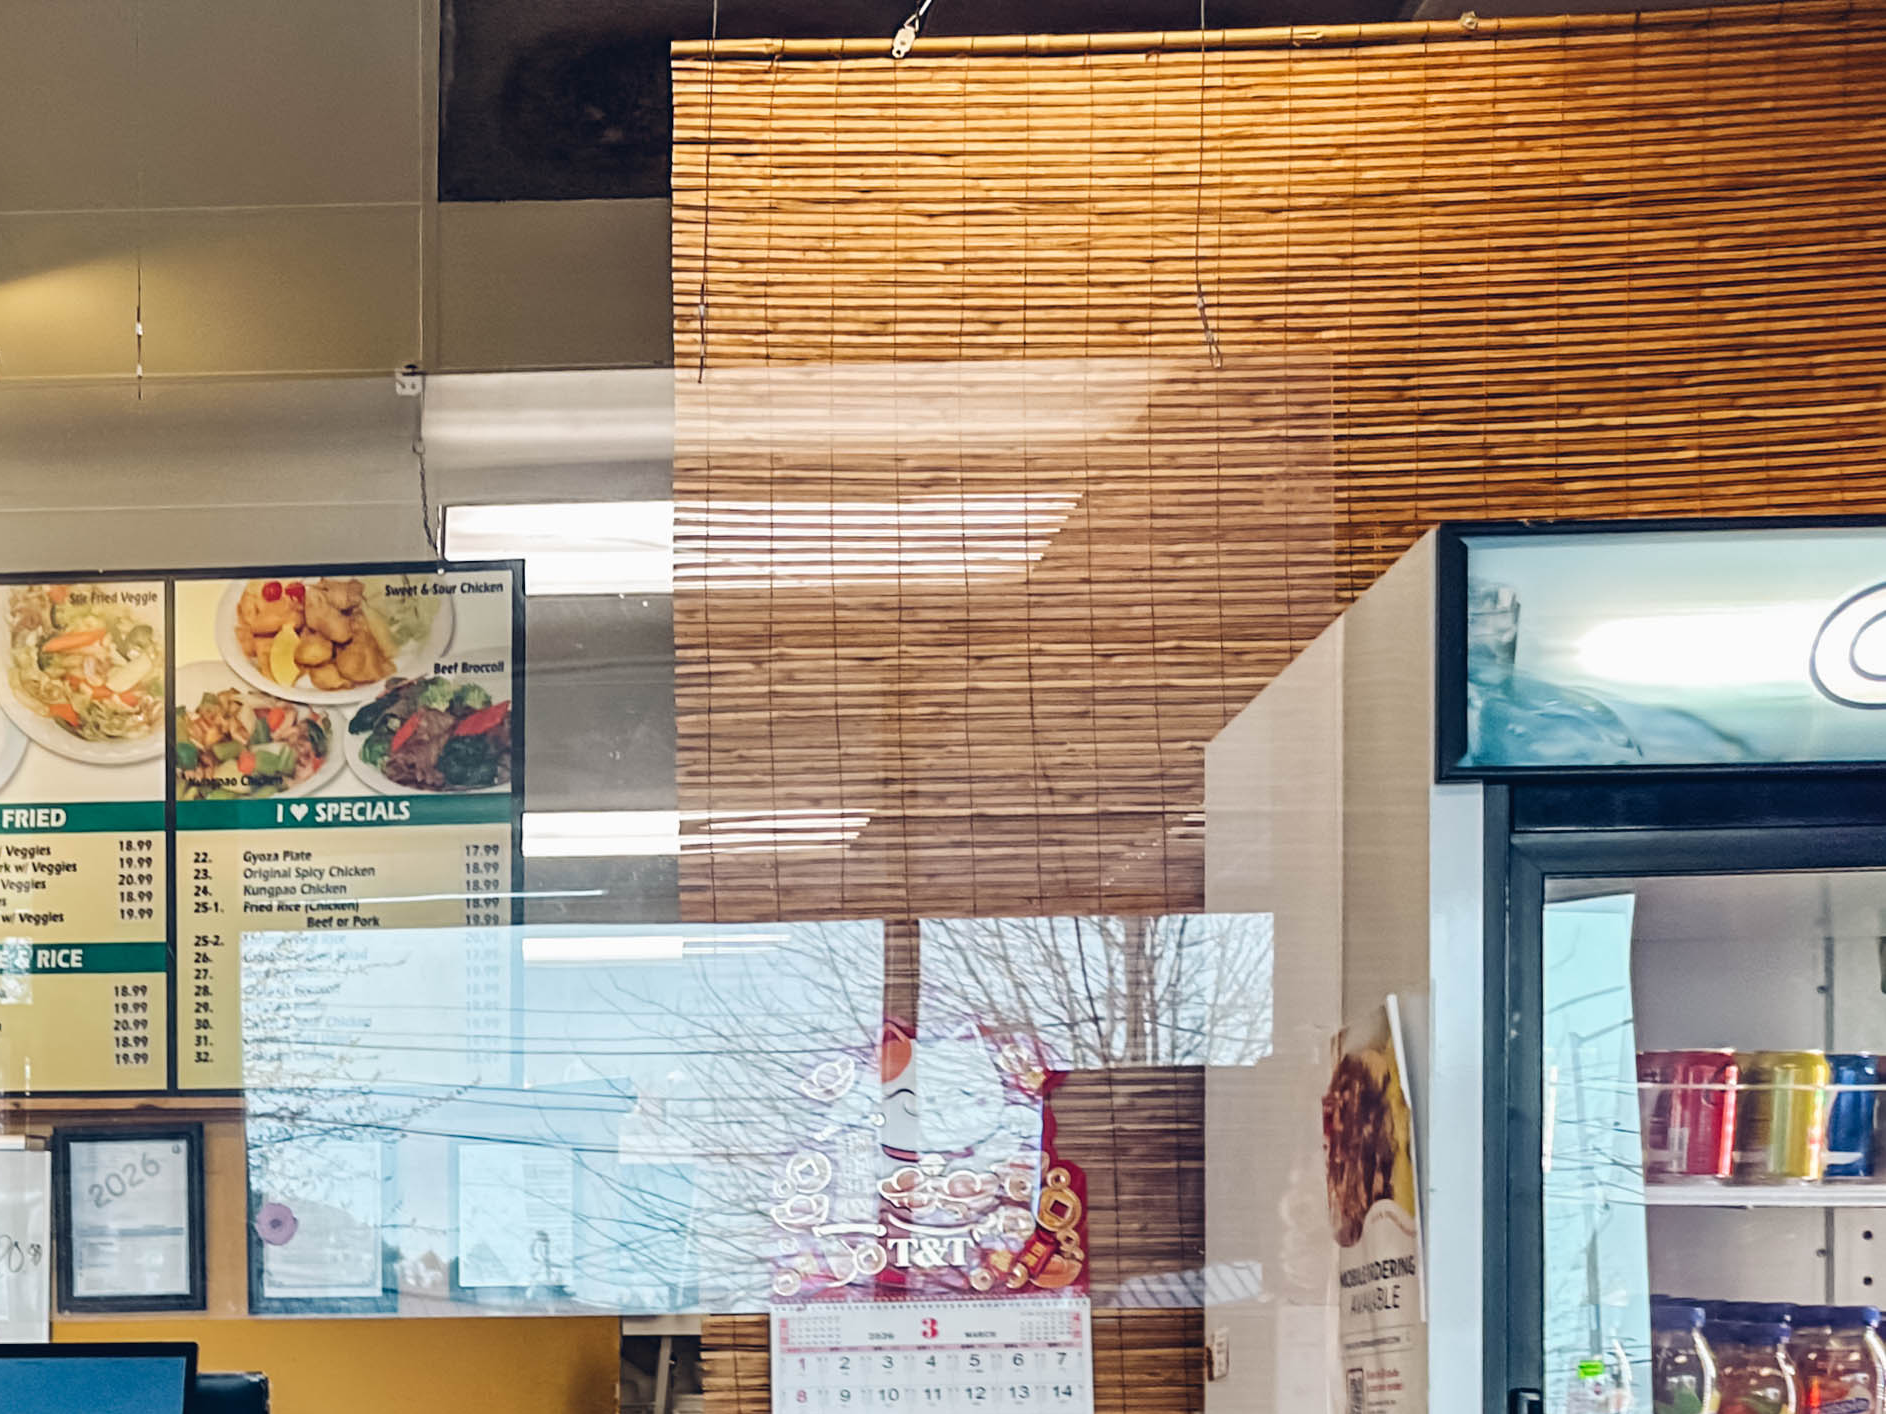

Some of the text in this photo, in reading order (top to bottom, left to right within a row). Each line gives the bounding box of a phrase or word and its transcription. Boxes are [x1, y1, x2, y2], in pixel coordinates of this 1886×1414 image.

[384, 581, 504, 597] Sweet & Sour Chicken
[69, 590, 158, 606] Stir Fried Veggie
[433, 660, 504, 676] Beef Broccoli
[2, 809, 67, 828] FRIED
[276, 801, 410, 823] I SPECIALS
[6, 846, 51, 858] Veggies
[118, 840, 152, 851] 18.99
[243, 851, 312, 864] Gyoza Plate
[32, 862, 77, 874] Veggies
[119, 857, 153, 868] 19.99
[244, 866, 376, 881] Original Spicy Chicken
[2, 879, 47, 891] Veggies
[118, 875, 153, 886] 20.99
[244, 883, 347, 897] Kungpao Chicken
[19, 912, 64, 925] Veggies
[307, 916, 380, 927] Beef or Pork
[37, 950, 83, 968] RICE
[87, 1152, 161, 1210] 2026
[886, 1236, 976, 1268] T&T
[921, 1317, 939, 1339] 3
[799, 1353, 1067, 1370] 1 2 3 4 5 6 7
[796, 1385, 1073, 1403] 8 9 10 11 12 13 14
